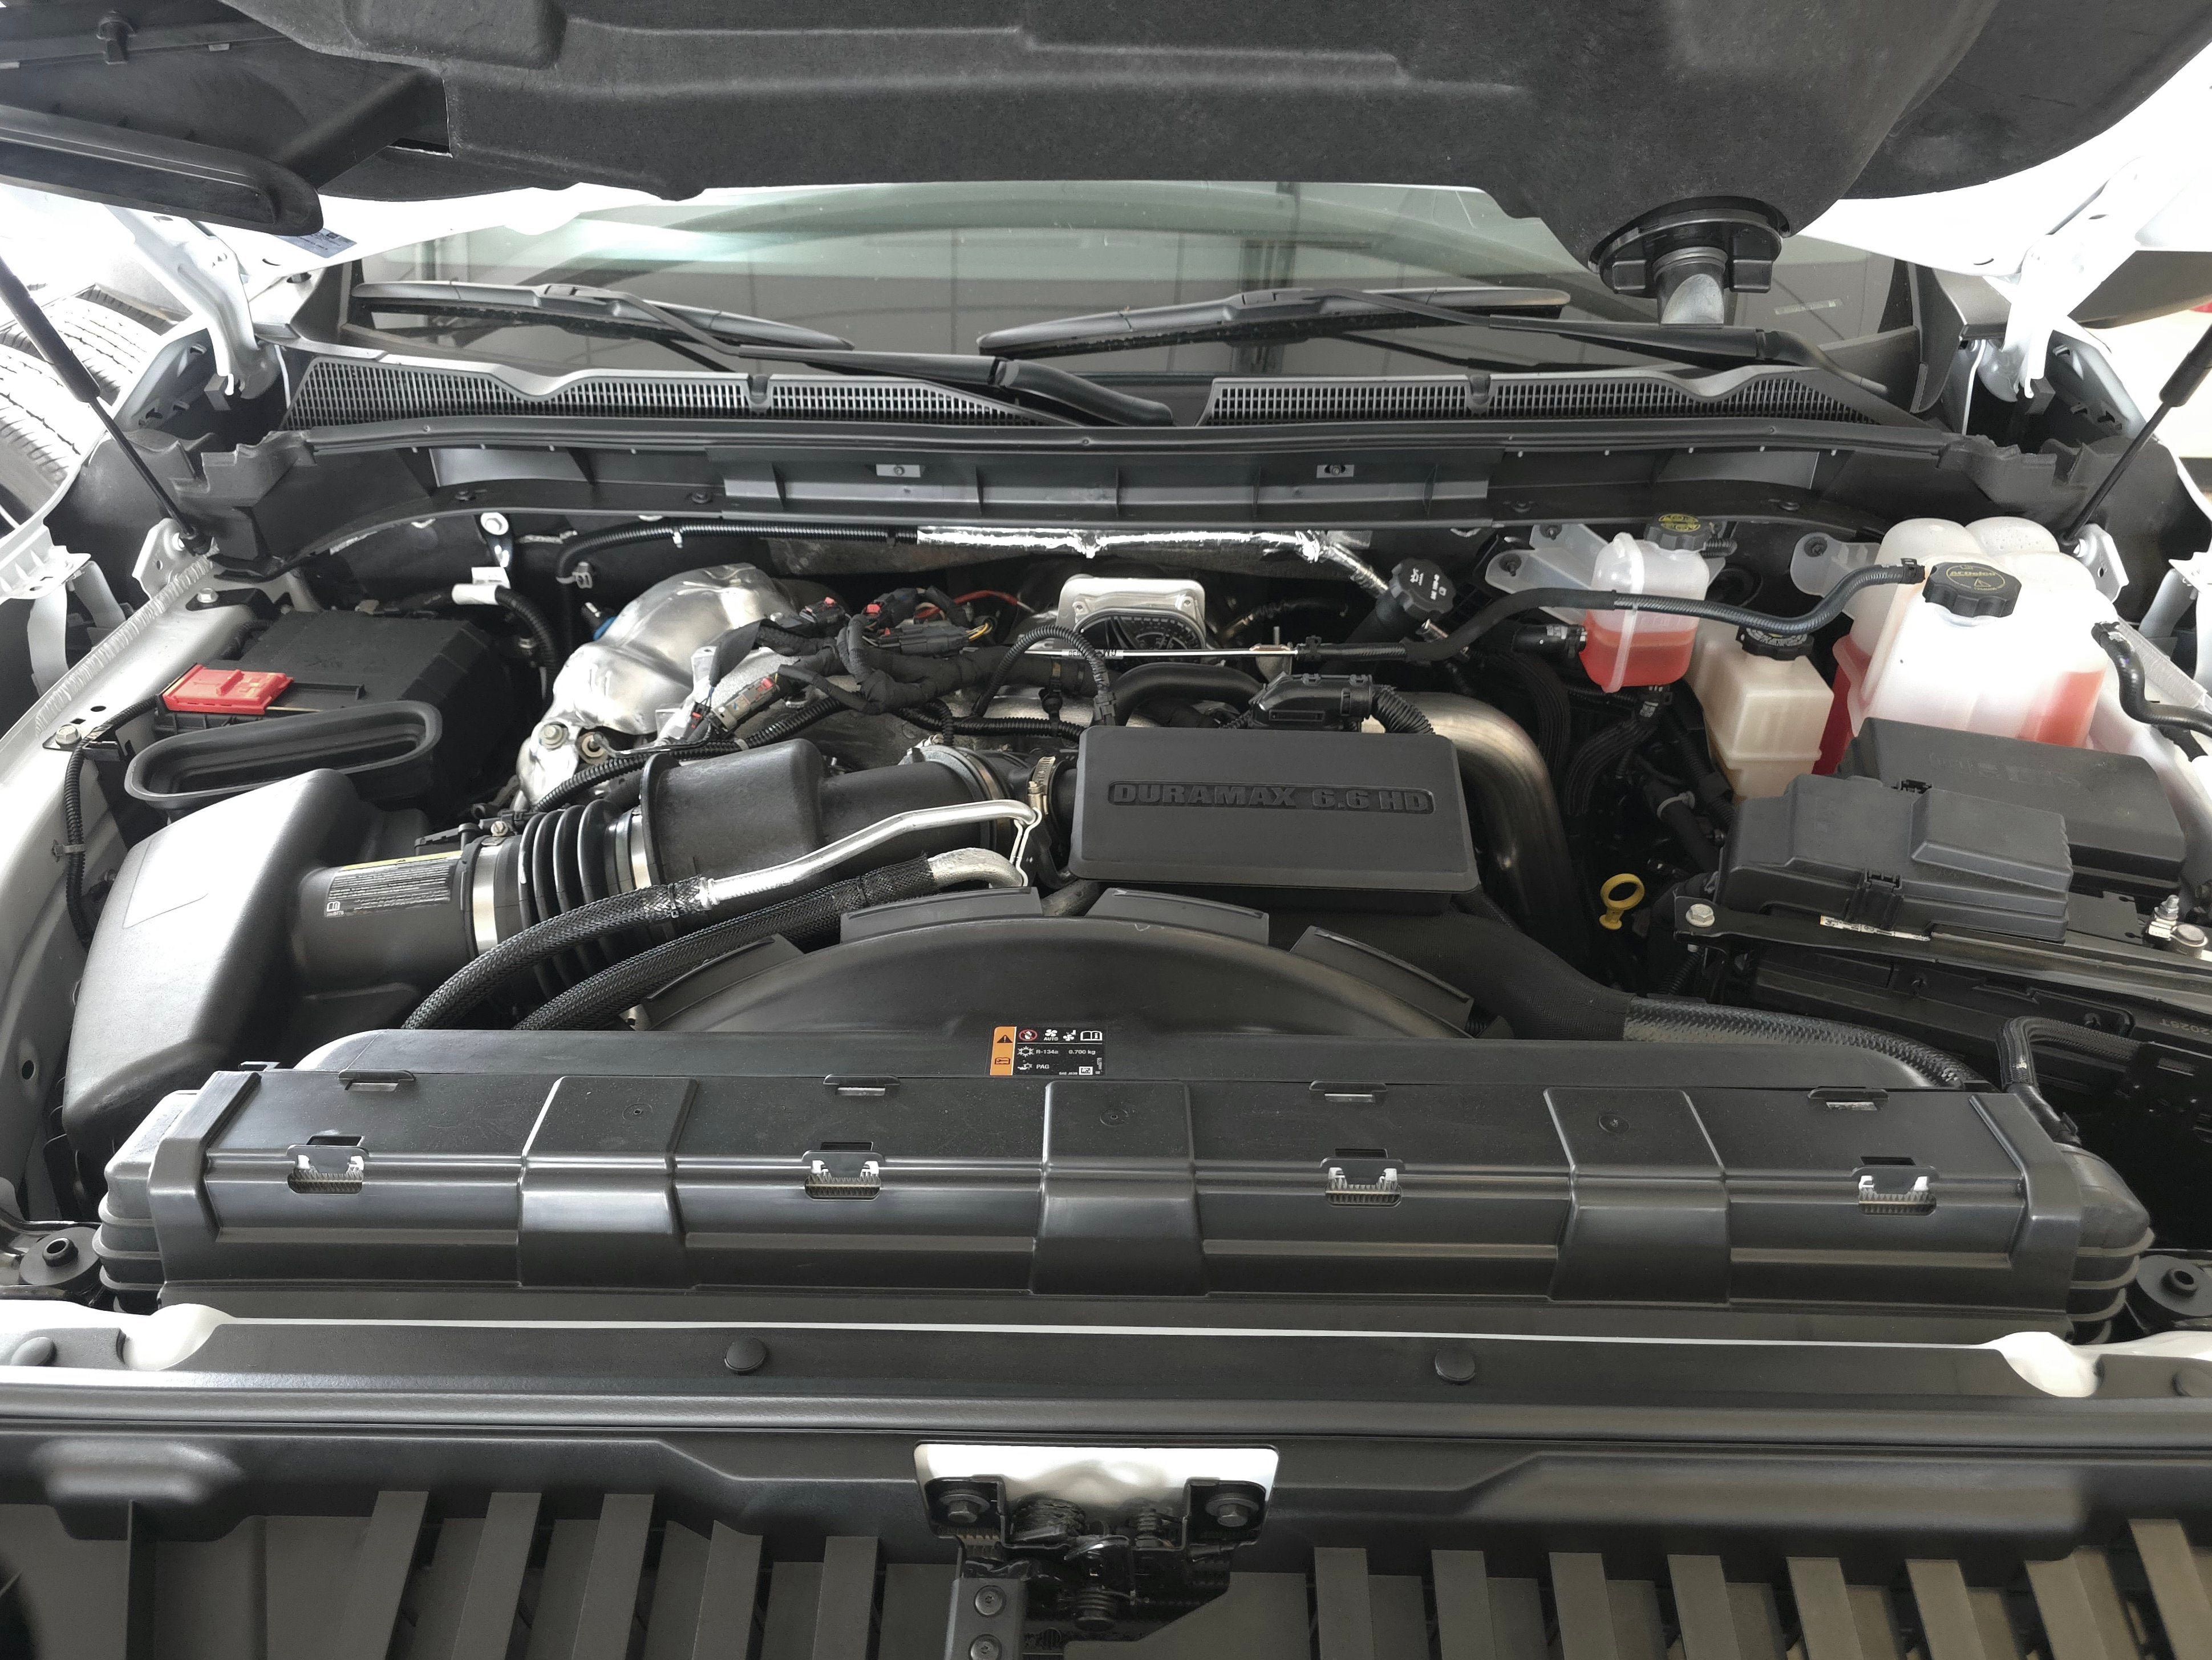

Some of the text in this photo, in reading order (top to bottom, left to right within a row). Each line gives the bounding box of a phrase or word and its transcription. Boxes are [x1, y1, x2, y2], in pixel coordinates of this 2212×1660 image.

[1113, 784, 1429, 812] DURAMAX 6.6 HD
